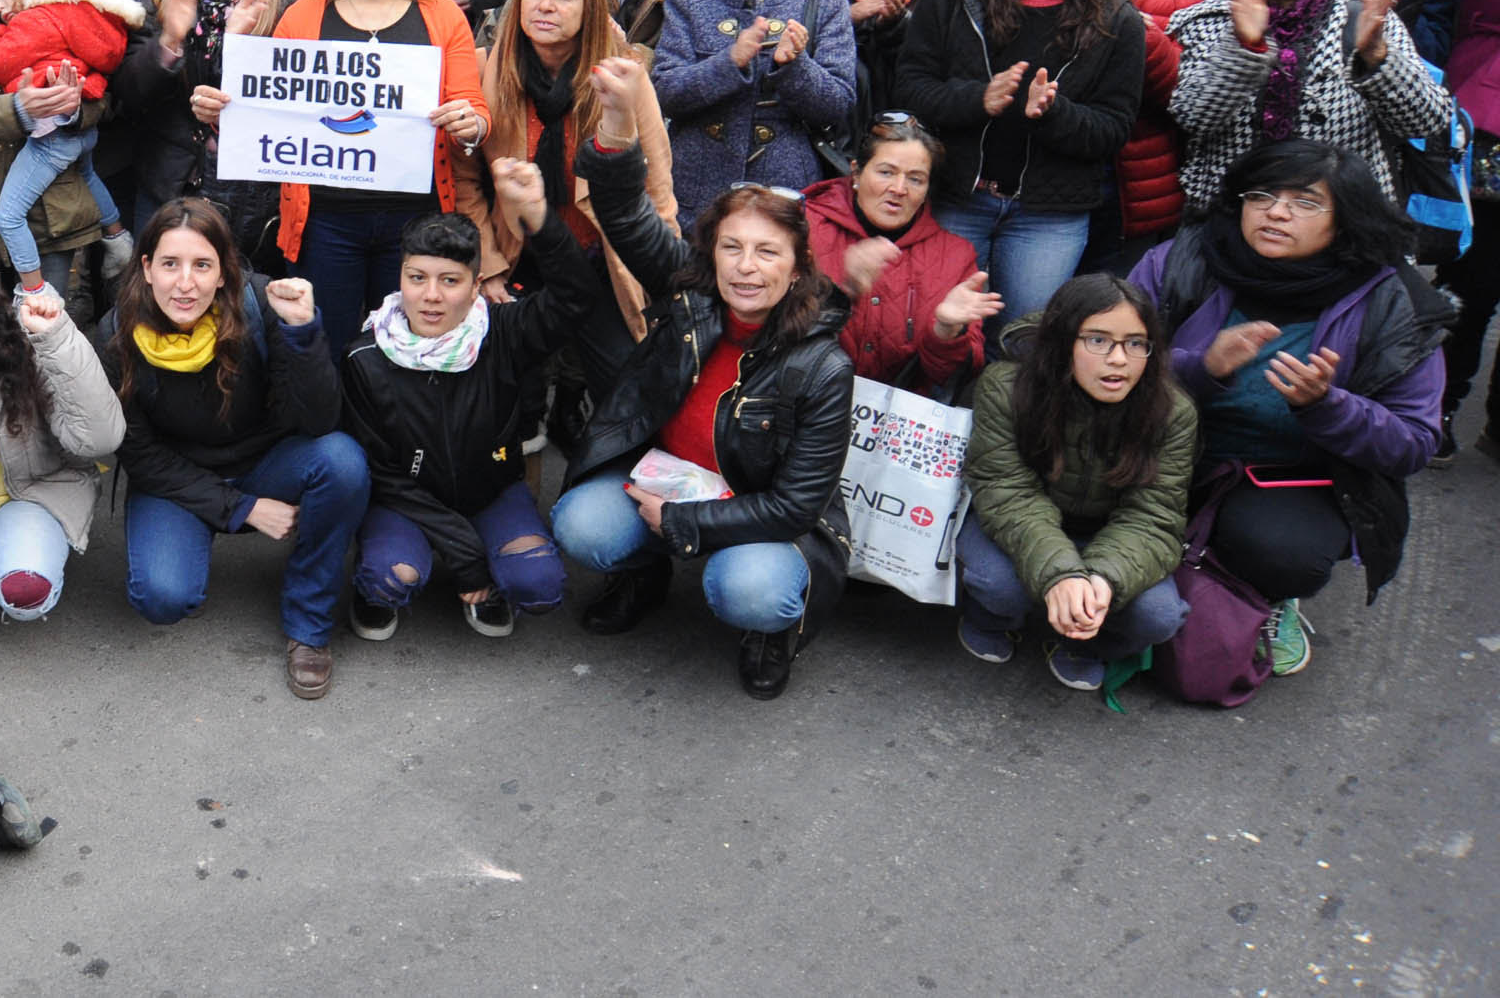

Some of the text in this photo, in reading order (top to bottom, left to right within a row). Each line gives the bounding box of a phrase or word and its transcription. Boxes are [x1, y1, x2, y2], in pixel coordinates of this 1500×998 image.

[272, 47, 382, 78] NO A LOS
[241, 74, 404, 110] DESPIDOS EN
[258, 133, 377, 173] télam
[257, 168, 375, 184] AGENCIA NACIONAL DE NOTICIAS
